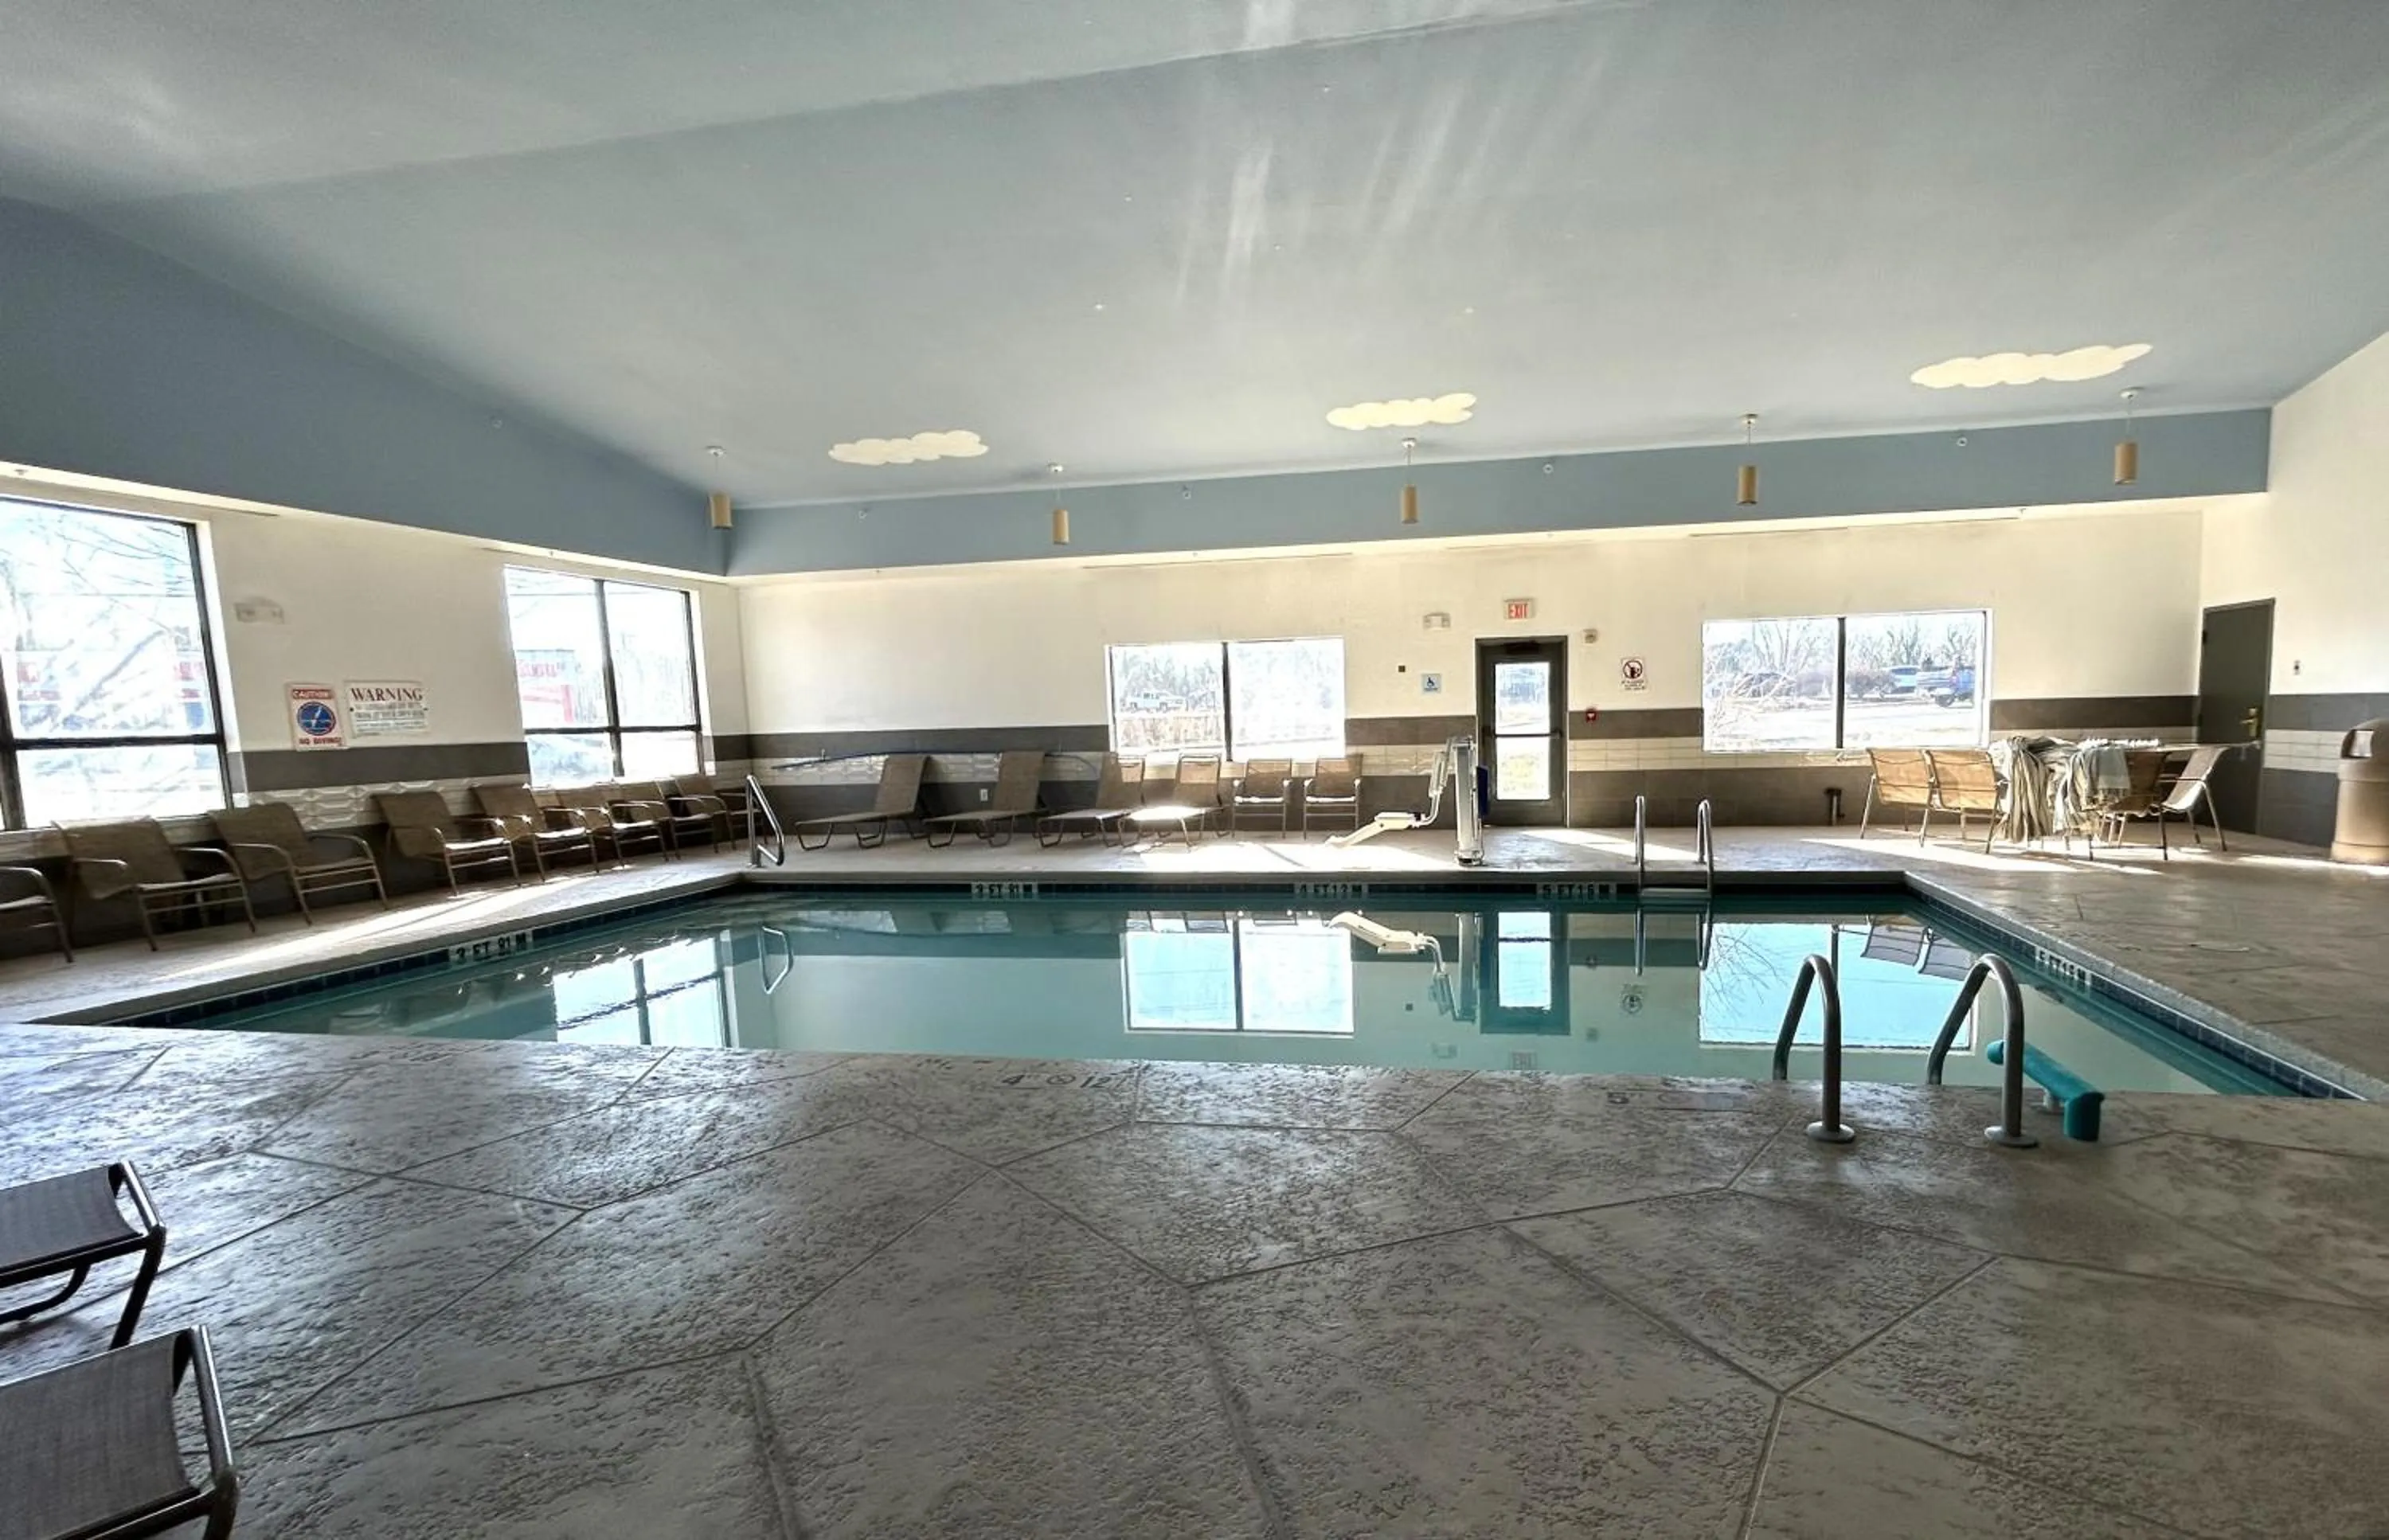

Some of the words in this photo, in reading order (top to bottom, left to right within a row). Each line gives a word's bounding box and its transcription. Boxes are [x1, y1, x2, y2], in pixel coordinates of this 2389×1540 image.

[1507, 603, 1529, 619] EXIT
[350, 687, 423, 702] WARNING
[473, 940, 491, 956] FT
